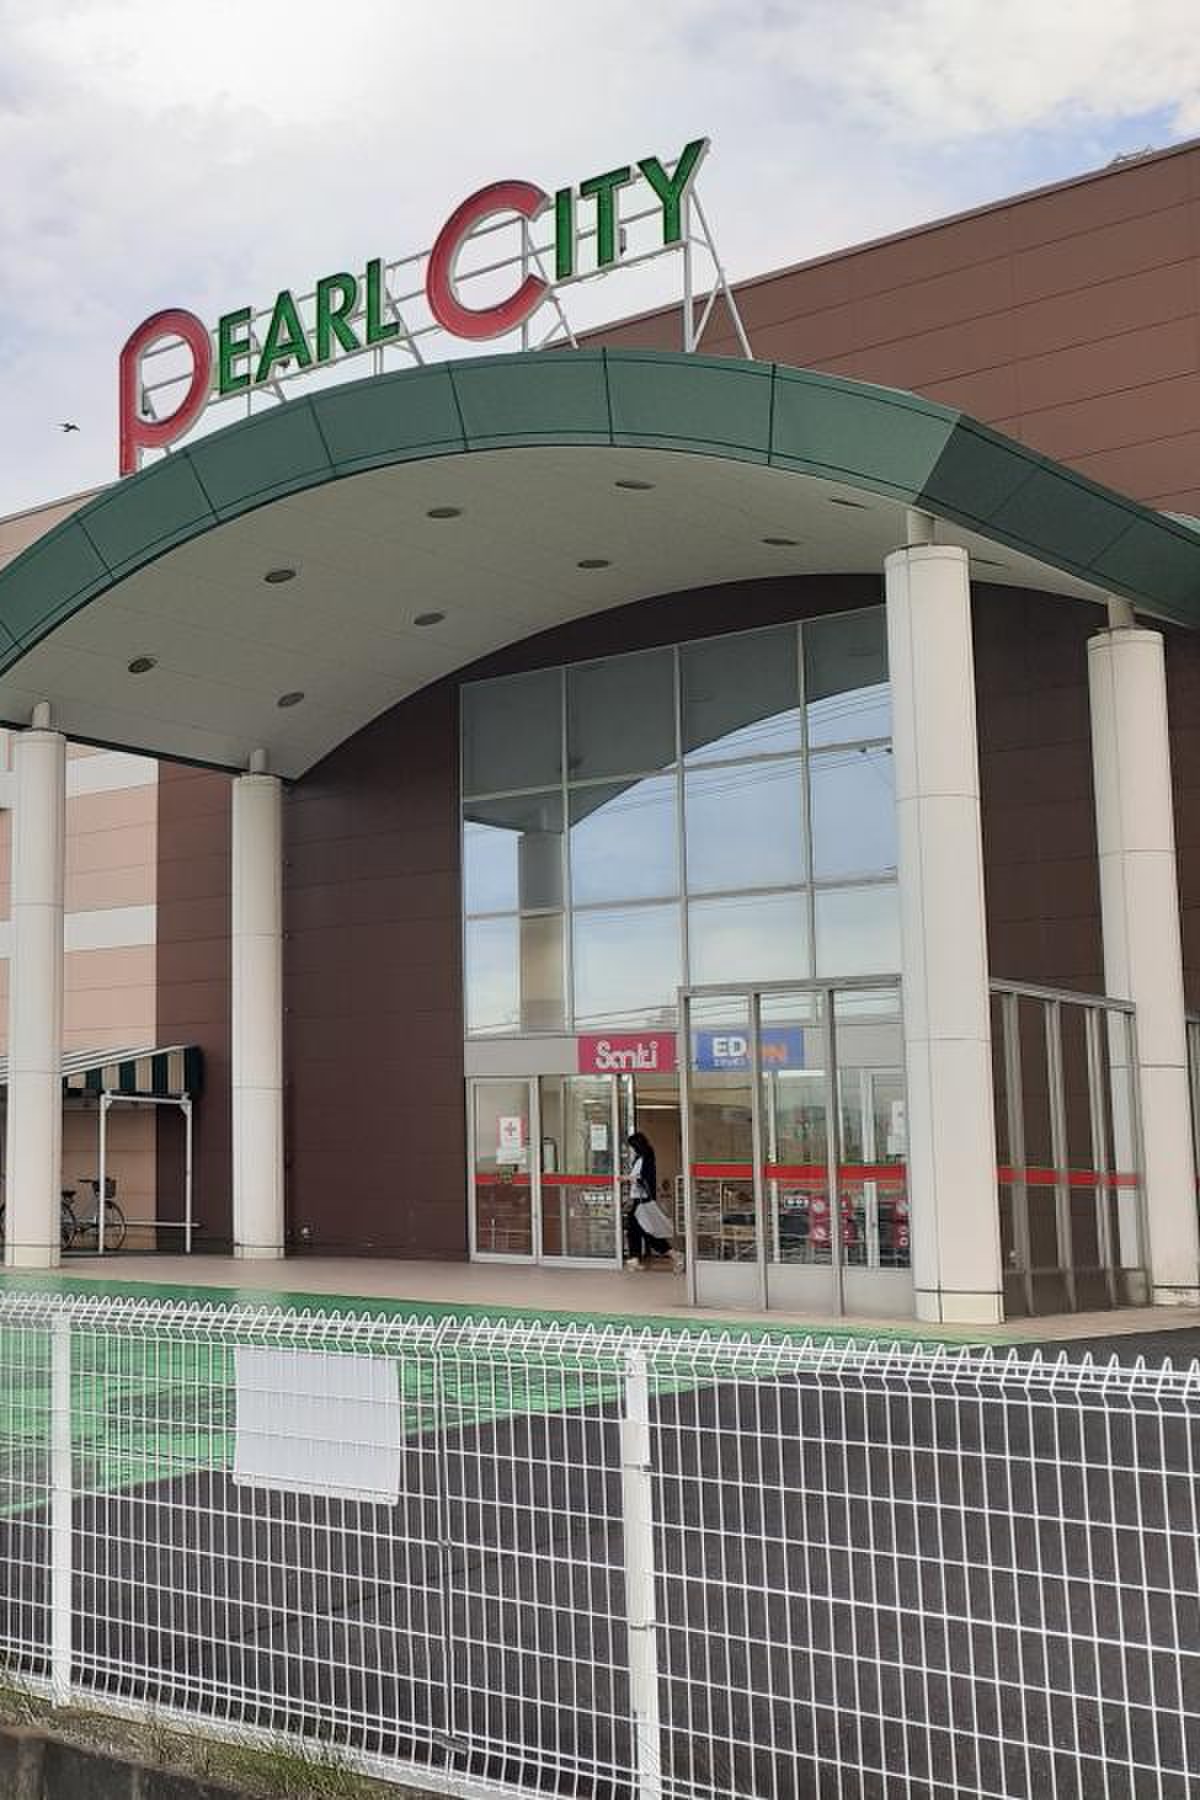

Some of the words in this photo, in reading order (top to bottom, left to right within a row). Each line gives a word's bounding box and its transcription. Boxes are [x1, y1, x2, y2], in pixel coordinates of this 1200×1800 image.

[119, 258, 401, 478] PEARL
[426, 138, 710, 341] CITY
[596, 1040, 658, 1069] Sanki
